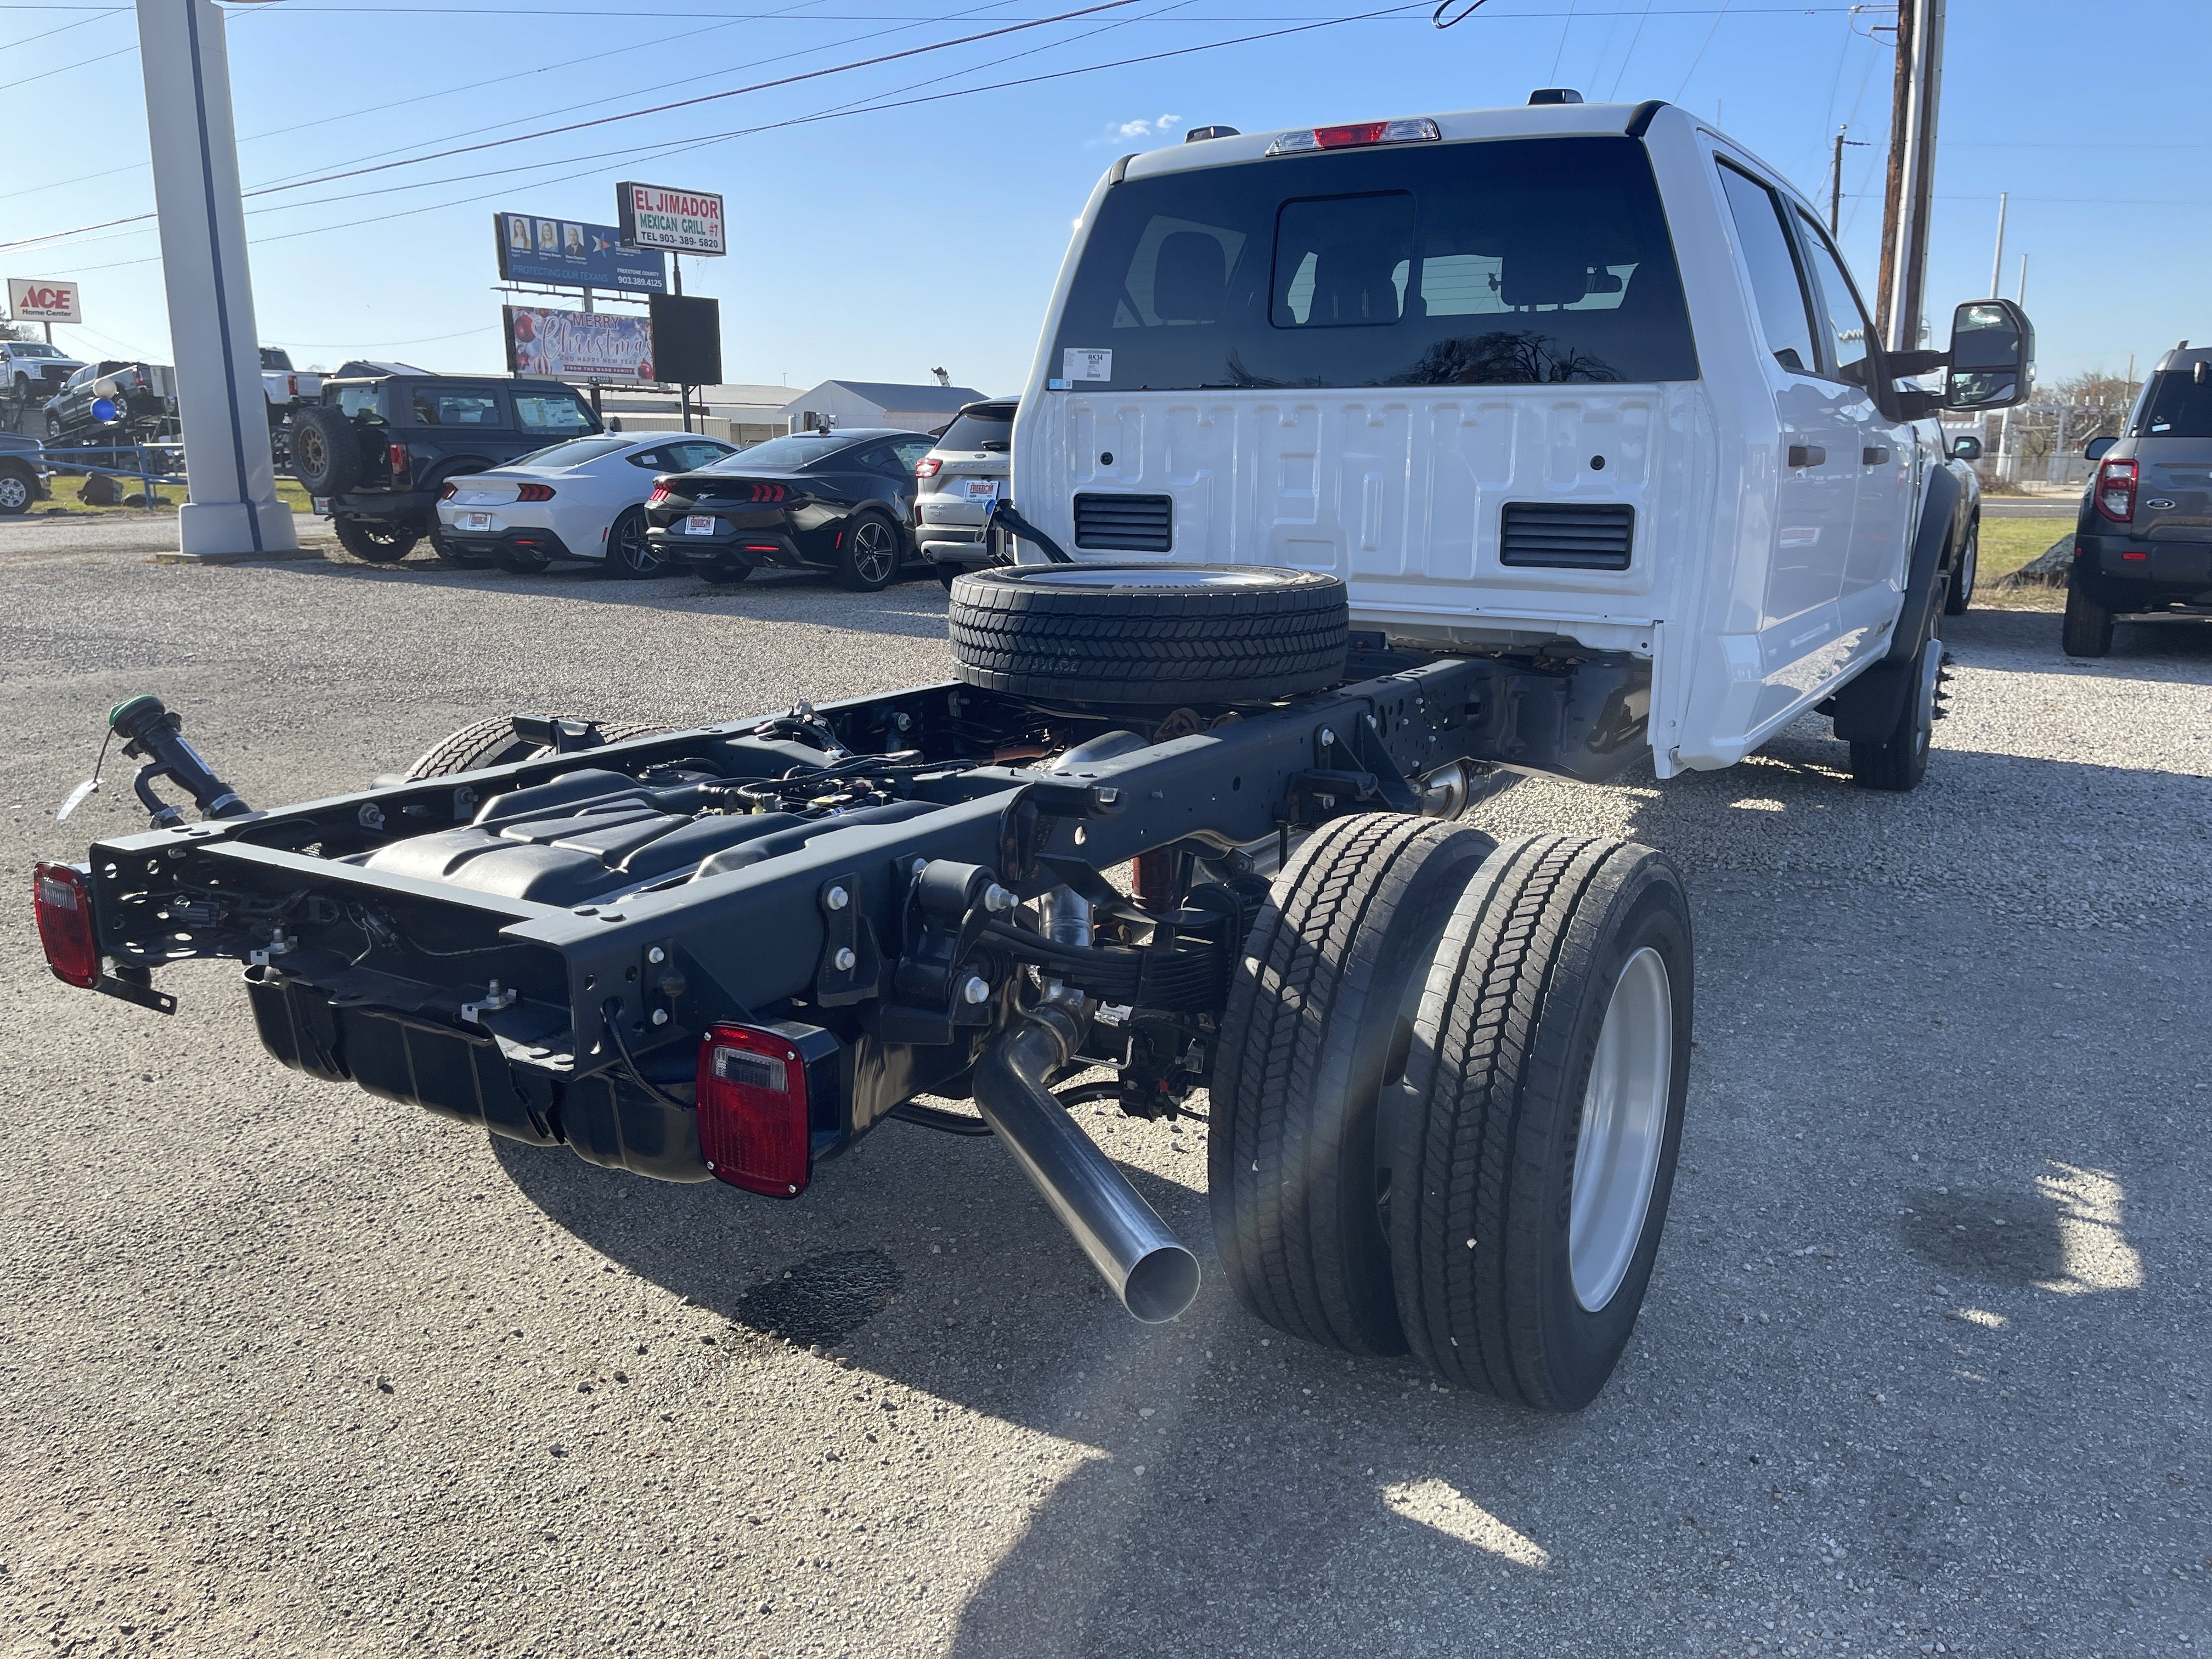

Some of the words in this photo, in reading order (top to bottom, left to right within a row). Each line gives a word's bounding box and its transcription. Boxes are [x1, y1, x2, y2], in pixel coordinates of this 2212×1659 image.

[635, 189, 653, 211] EL
[656, 193, 719, 219] JIMADOR
[640, 213, 678, 232] MEXICAN
[682, 219, 706, 235] GRILL
[709, 222, 719, 237] #7
[641, 232, 657, 241] TEL
[699, 238, 718, 248] 5820
[512, 264, 561, 278] PROTECTING
[563, 269, 578, 280] OUR
[580, 272, 609, 283] TEXANS
[617, 276, 662, 287] 903.389.4125
[20, 285, 71, 309] ACE
[572, 313, 619, 329] MERRY
[531, 315, 653, 361] Christmas
